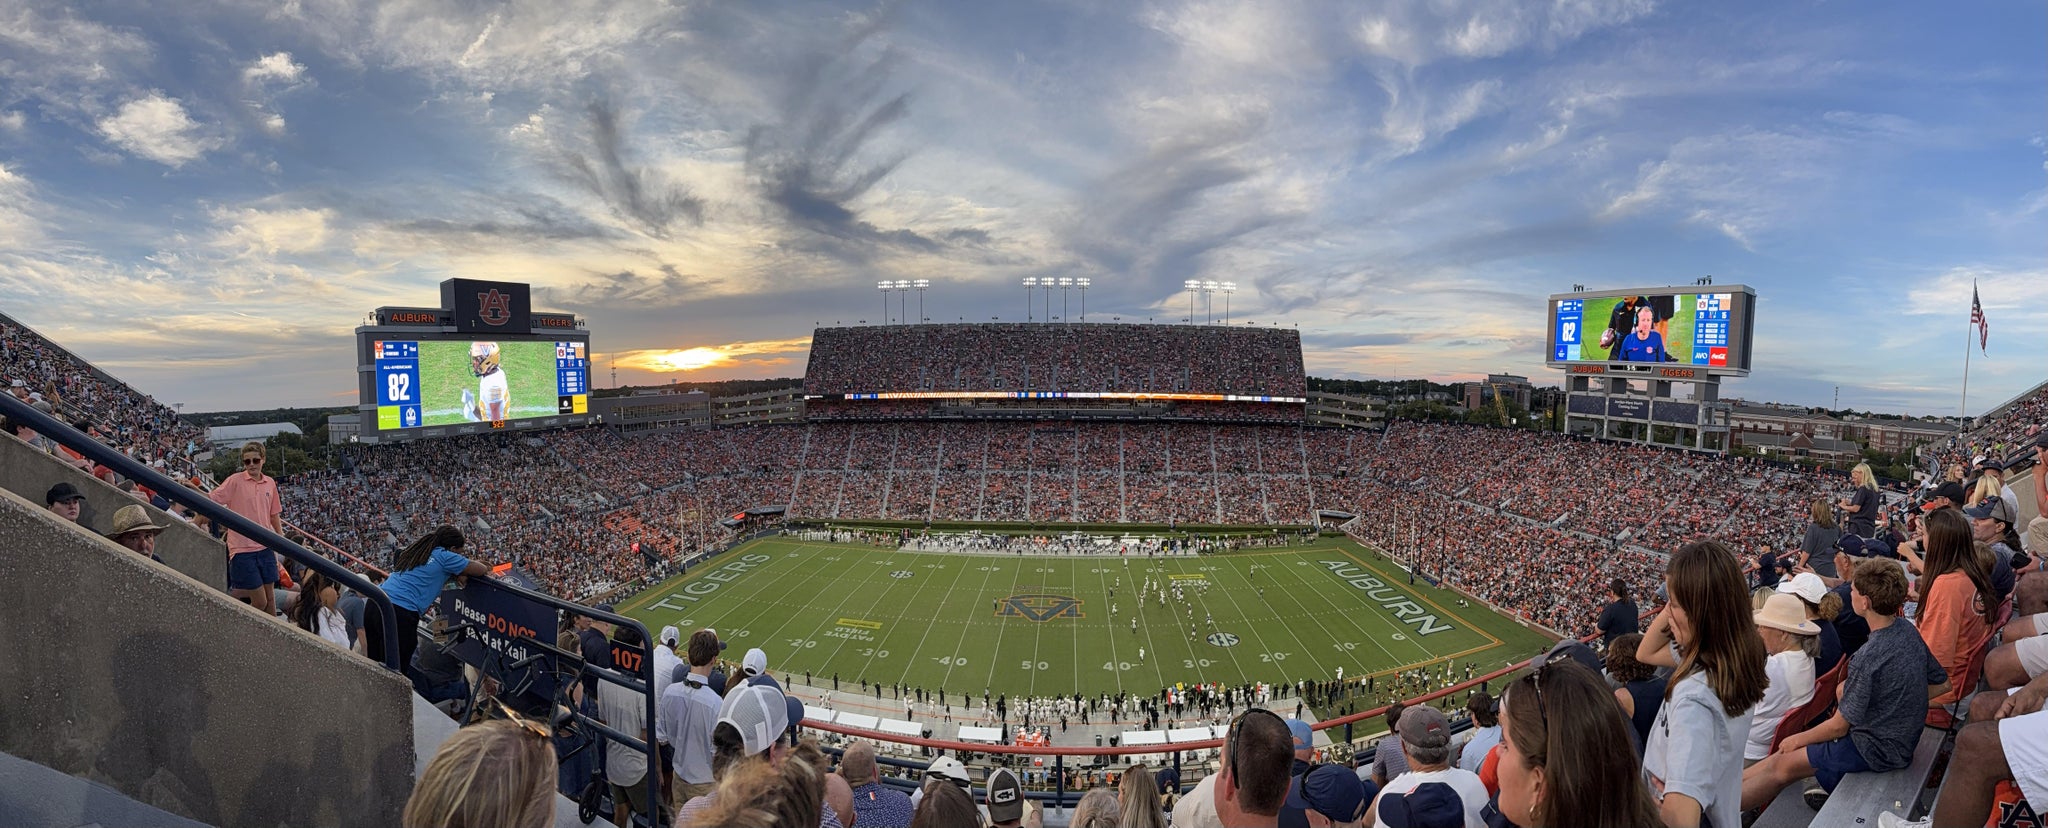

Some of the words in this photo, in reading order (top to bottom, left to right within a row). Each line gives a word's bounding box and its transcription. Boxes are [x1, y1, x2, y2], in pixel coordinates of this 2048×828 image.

[391, 313, 436, 323] AUBURN
[541, 317, 572, 327] TIGERS
[1562, 322, 1576, 342] 82
[1572, 365, 1605, 374] AUBURN
[1660, 368, 1695, 378] TIGERS
[388, 373, 411, 402] 82
[644, 553, 772, 612] TIGERS
[1317, 559, 1456, 637] AUBURN
[455, 598, 487, 624] Please
[488, 613, 507, 633] DO
[491, 637, 502, 652] at
[790, 638, 818, 648] 20
[1333, 641, 1357, 652] 10
[861, 647, 889, 658] 30
[1259, 651, 1286, 663] 20
[611, 647, 643, 673] 107
[938, 655, 967, 666] 40
[1021, 660, 1049, 670] 50
[1183, 658, 1210, 669] 30
[1103, 661, 1131, 671] 40
